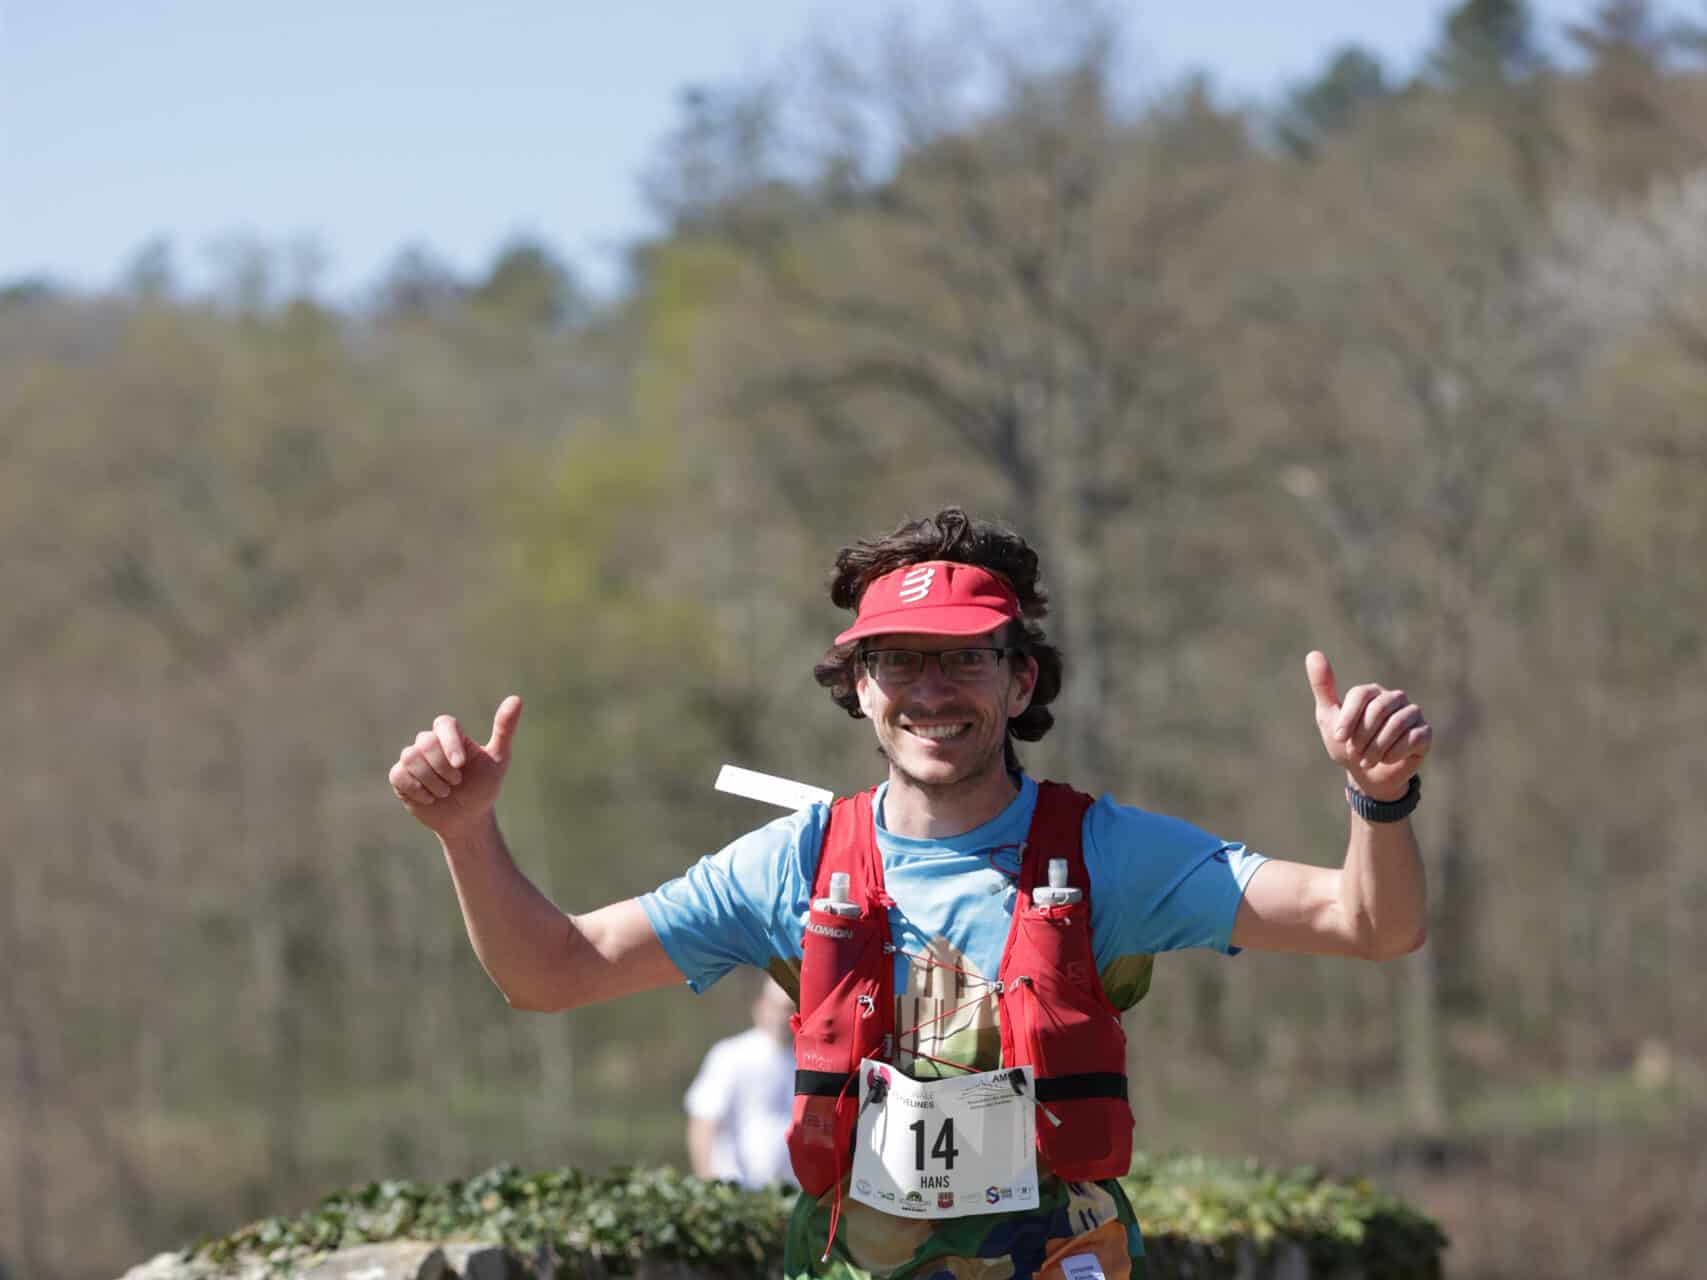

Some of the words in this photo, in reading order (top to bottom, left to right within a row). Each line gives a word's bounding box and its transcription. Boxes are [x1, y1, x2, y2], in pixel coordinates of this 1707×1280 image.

[806, 922, 853, 939] ALOMON
[909, 1117, 959, 1171] 14
[920, 1175, 950, 1189] HANS
